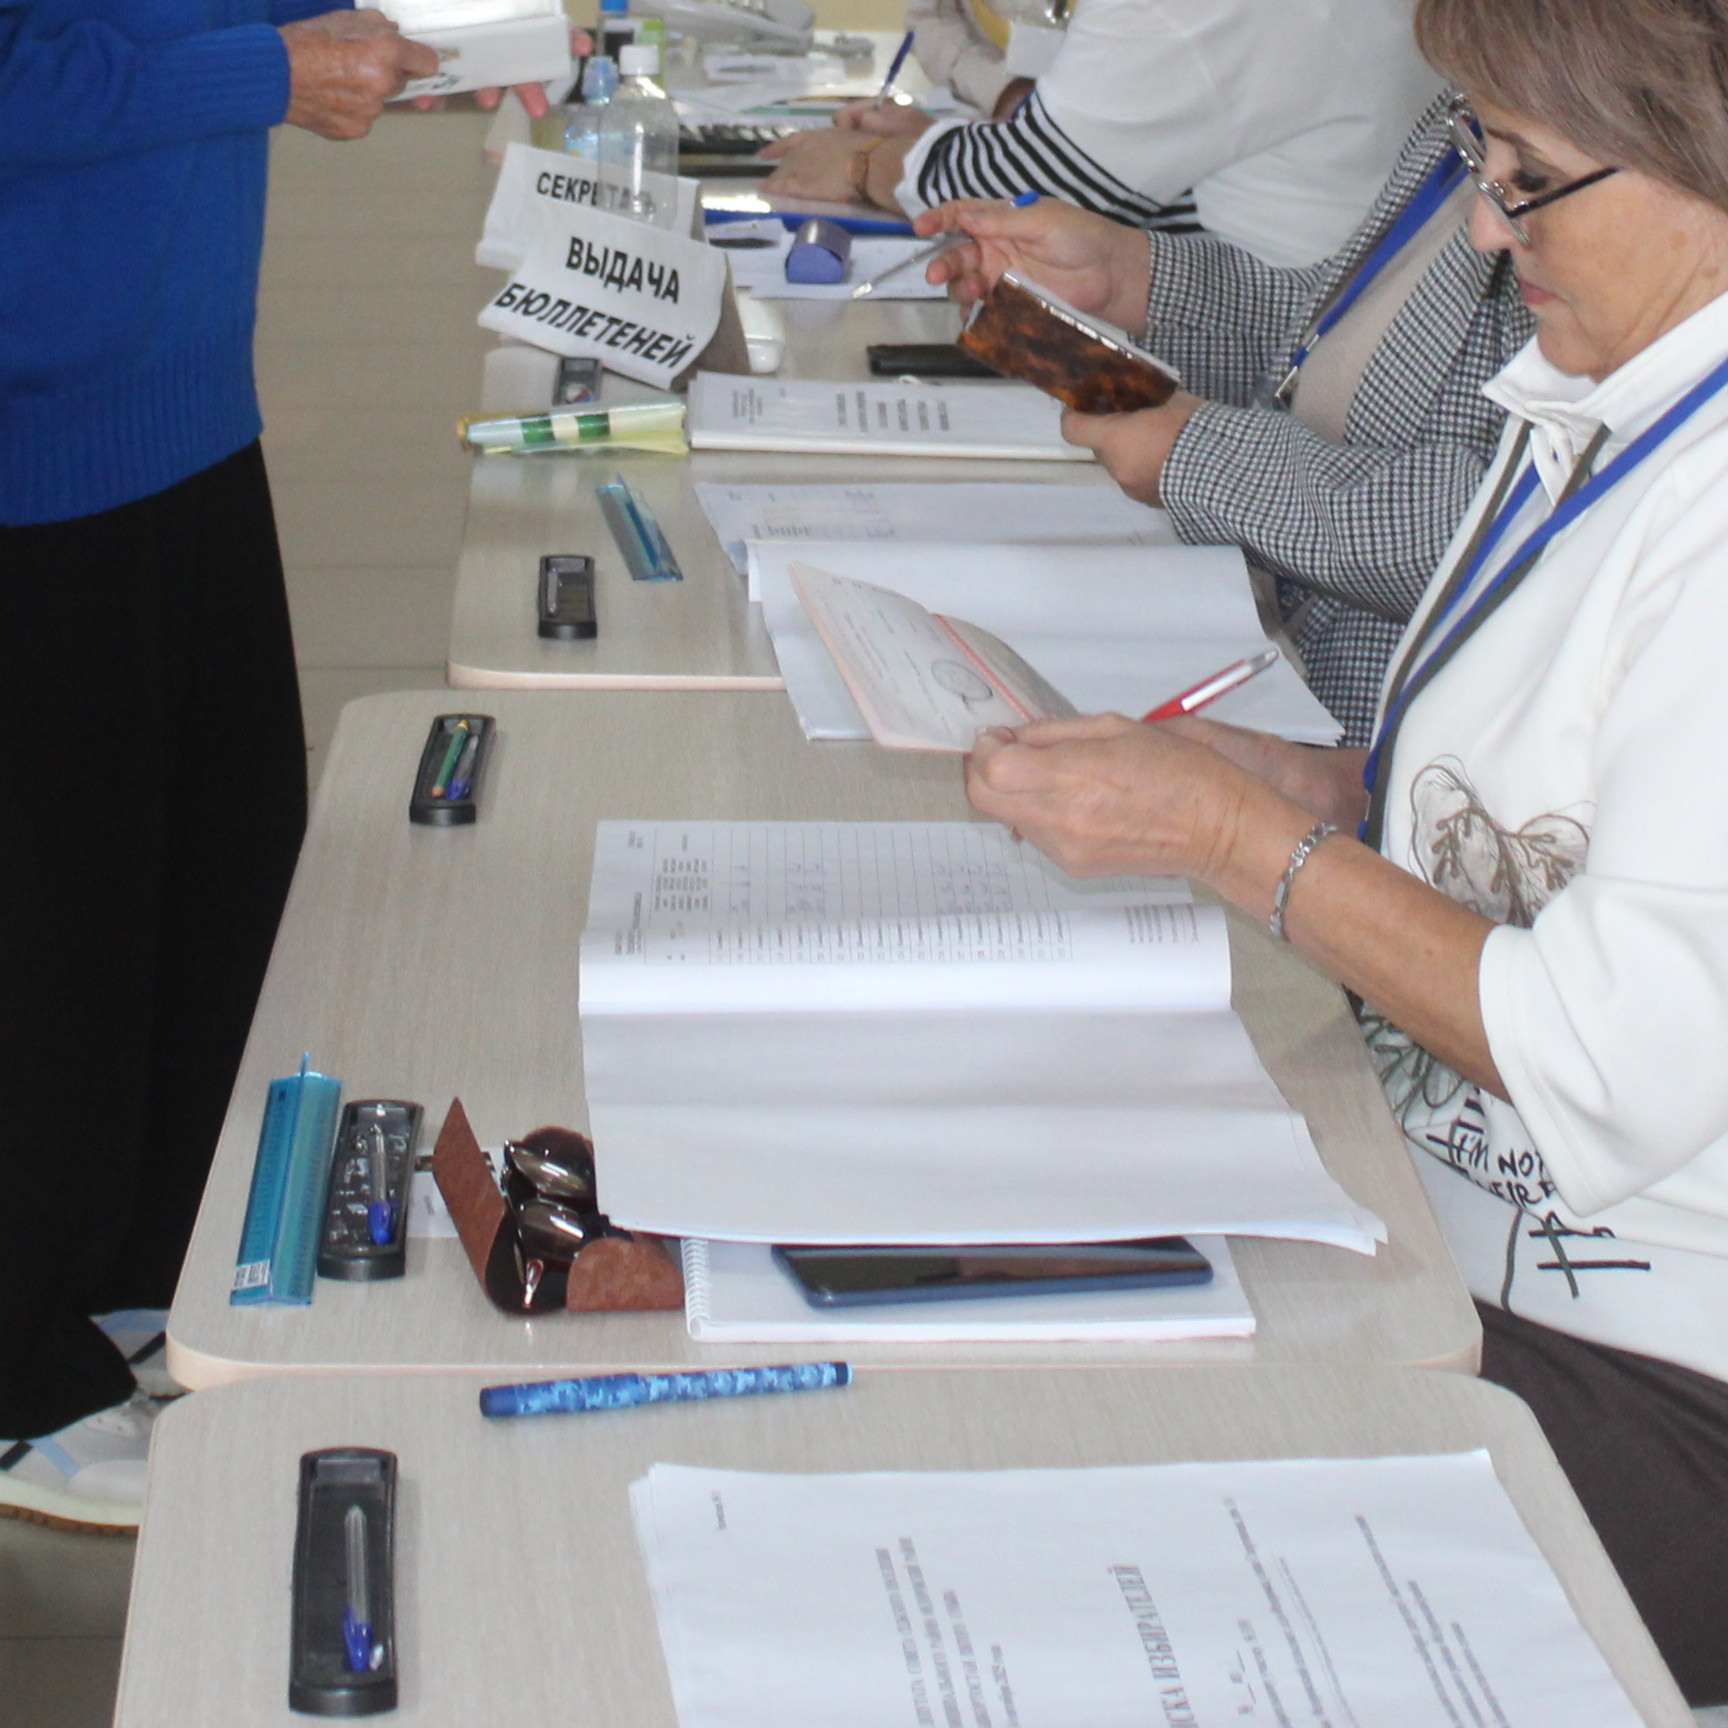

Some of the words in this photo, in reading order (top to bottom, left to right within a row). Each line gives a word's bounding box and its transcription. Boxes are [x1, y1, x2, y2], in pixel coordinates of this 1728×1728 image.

[566, 236, 680, 304] ВЫДАЧА
[494, 283, 695, 368] БЮЛЛЕТЕНЕЙ
[1107, 1564, 1180, 1679] ИЗБИРАТЕЛЕЙ
